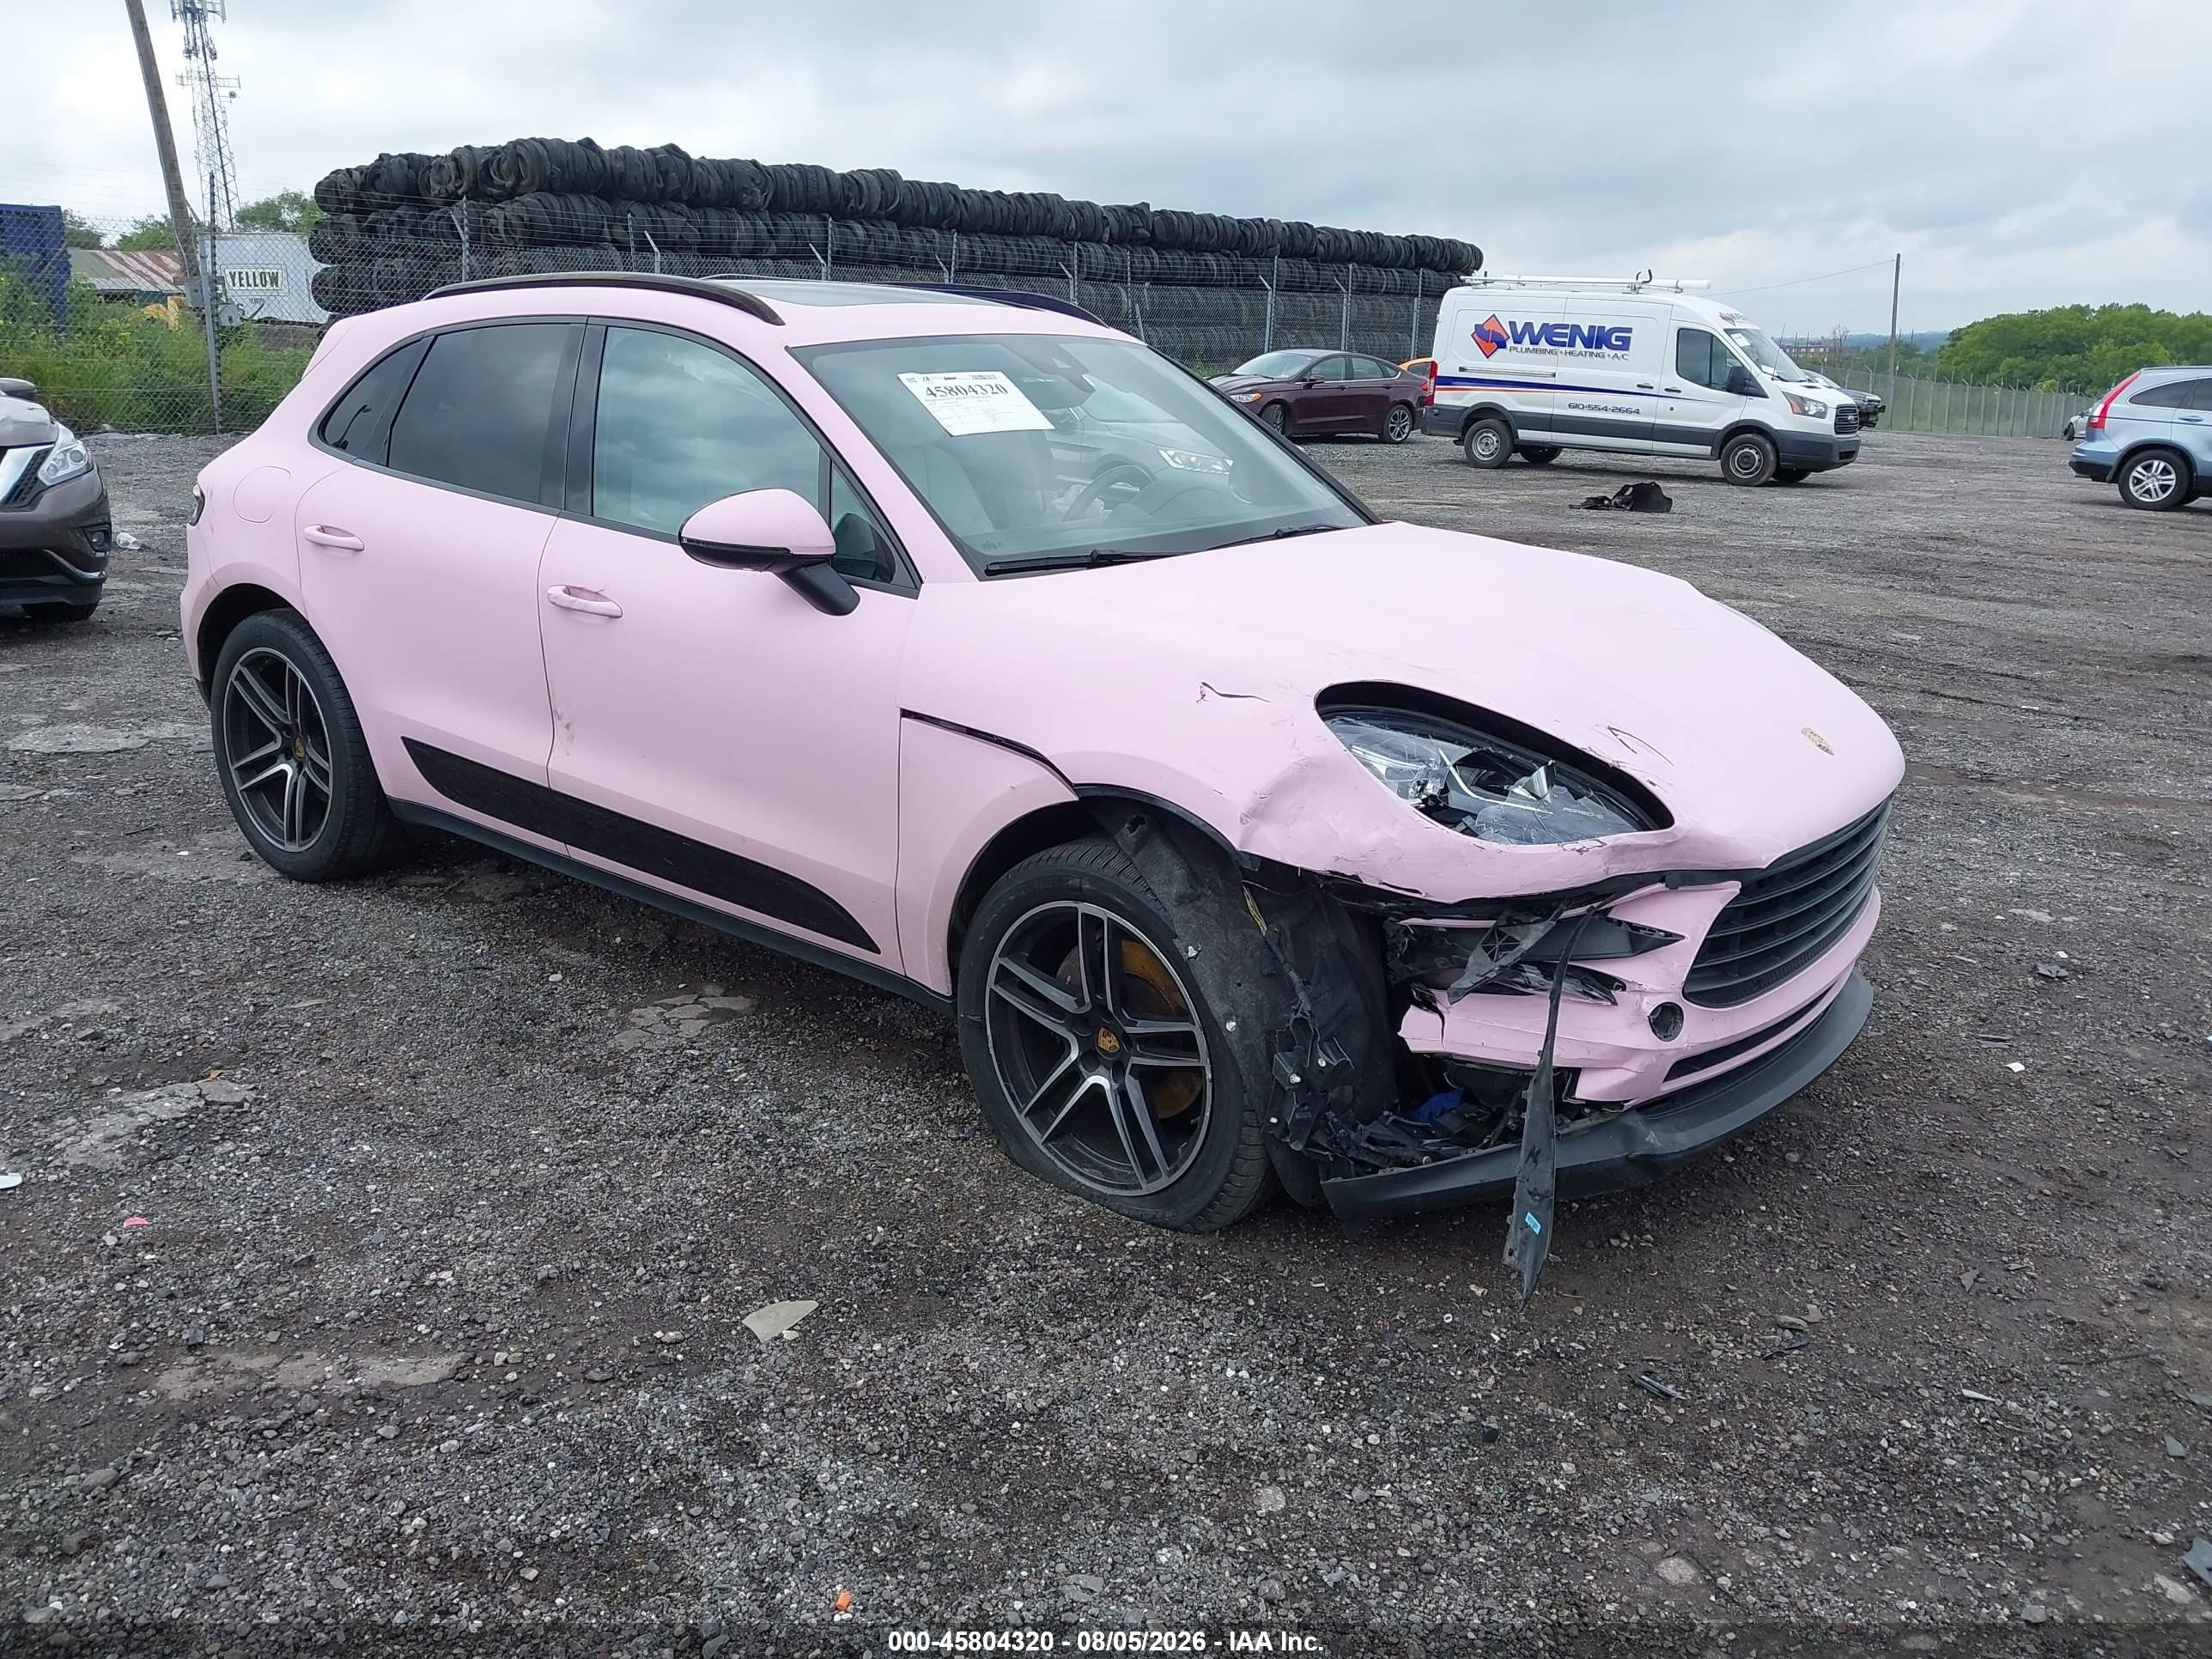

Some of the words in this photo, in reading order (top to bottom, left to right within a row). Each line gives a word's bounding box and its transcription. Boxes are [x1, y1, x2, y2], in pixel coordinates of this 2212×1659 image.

[228, 271, 279, 288] YELLOW
[1509, 320, 1632, 351] WENIG
[1509, 346, 1558, 356] PLUMBING
[1564, 349, 1605, 359] HEATING
[926, 383, 1008, 398] 45804320
